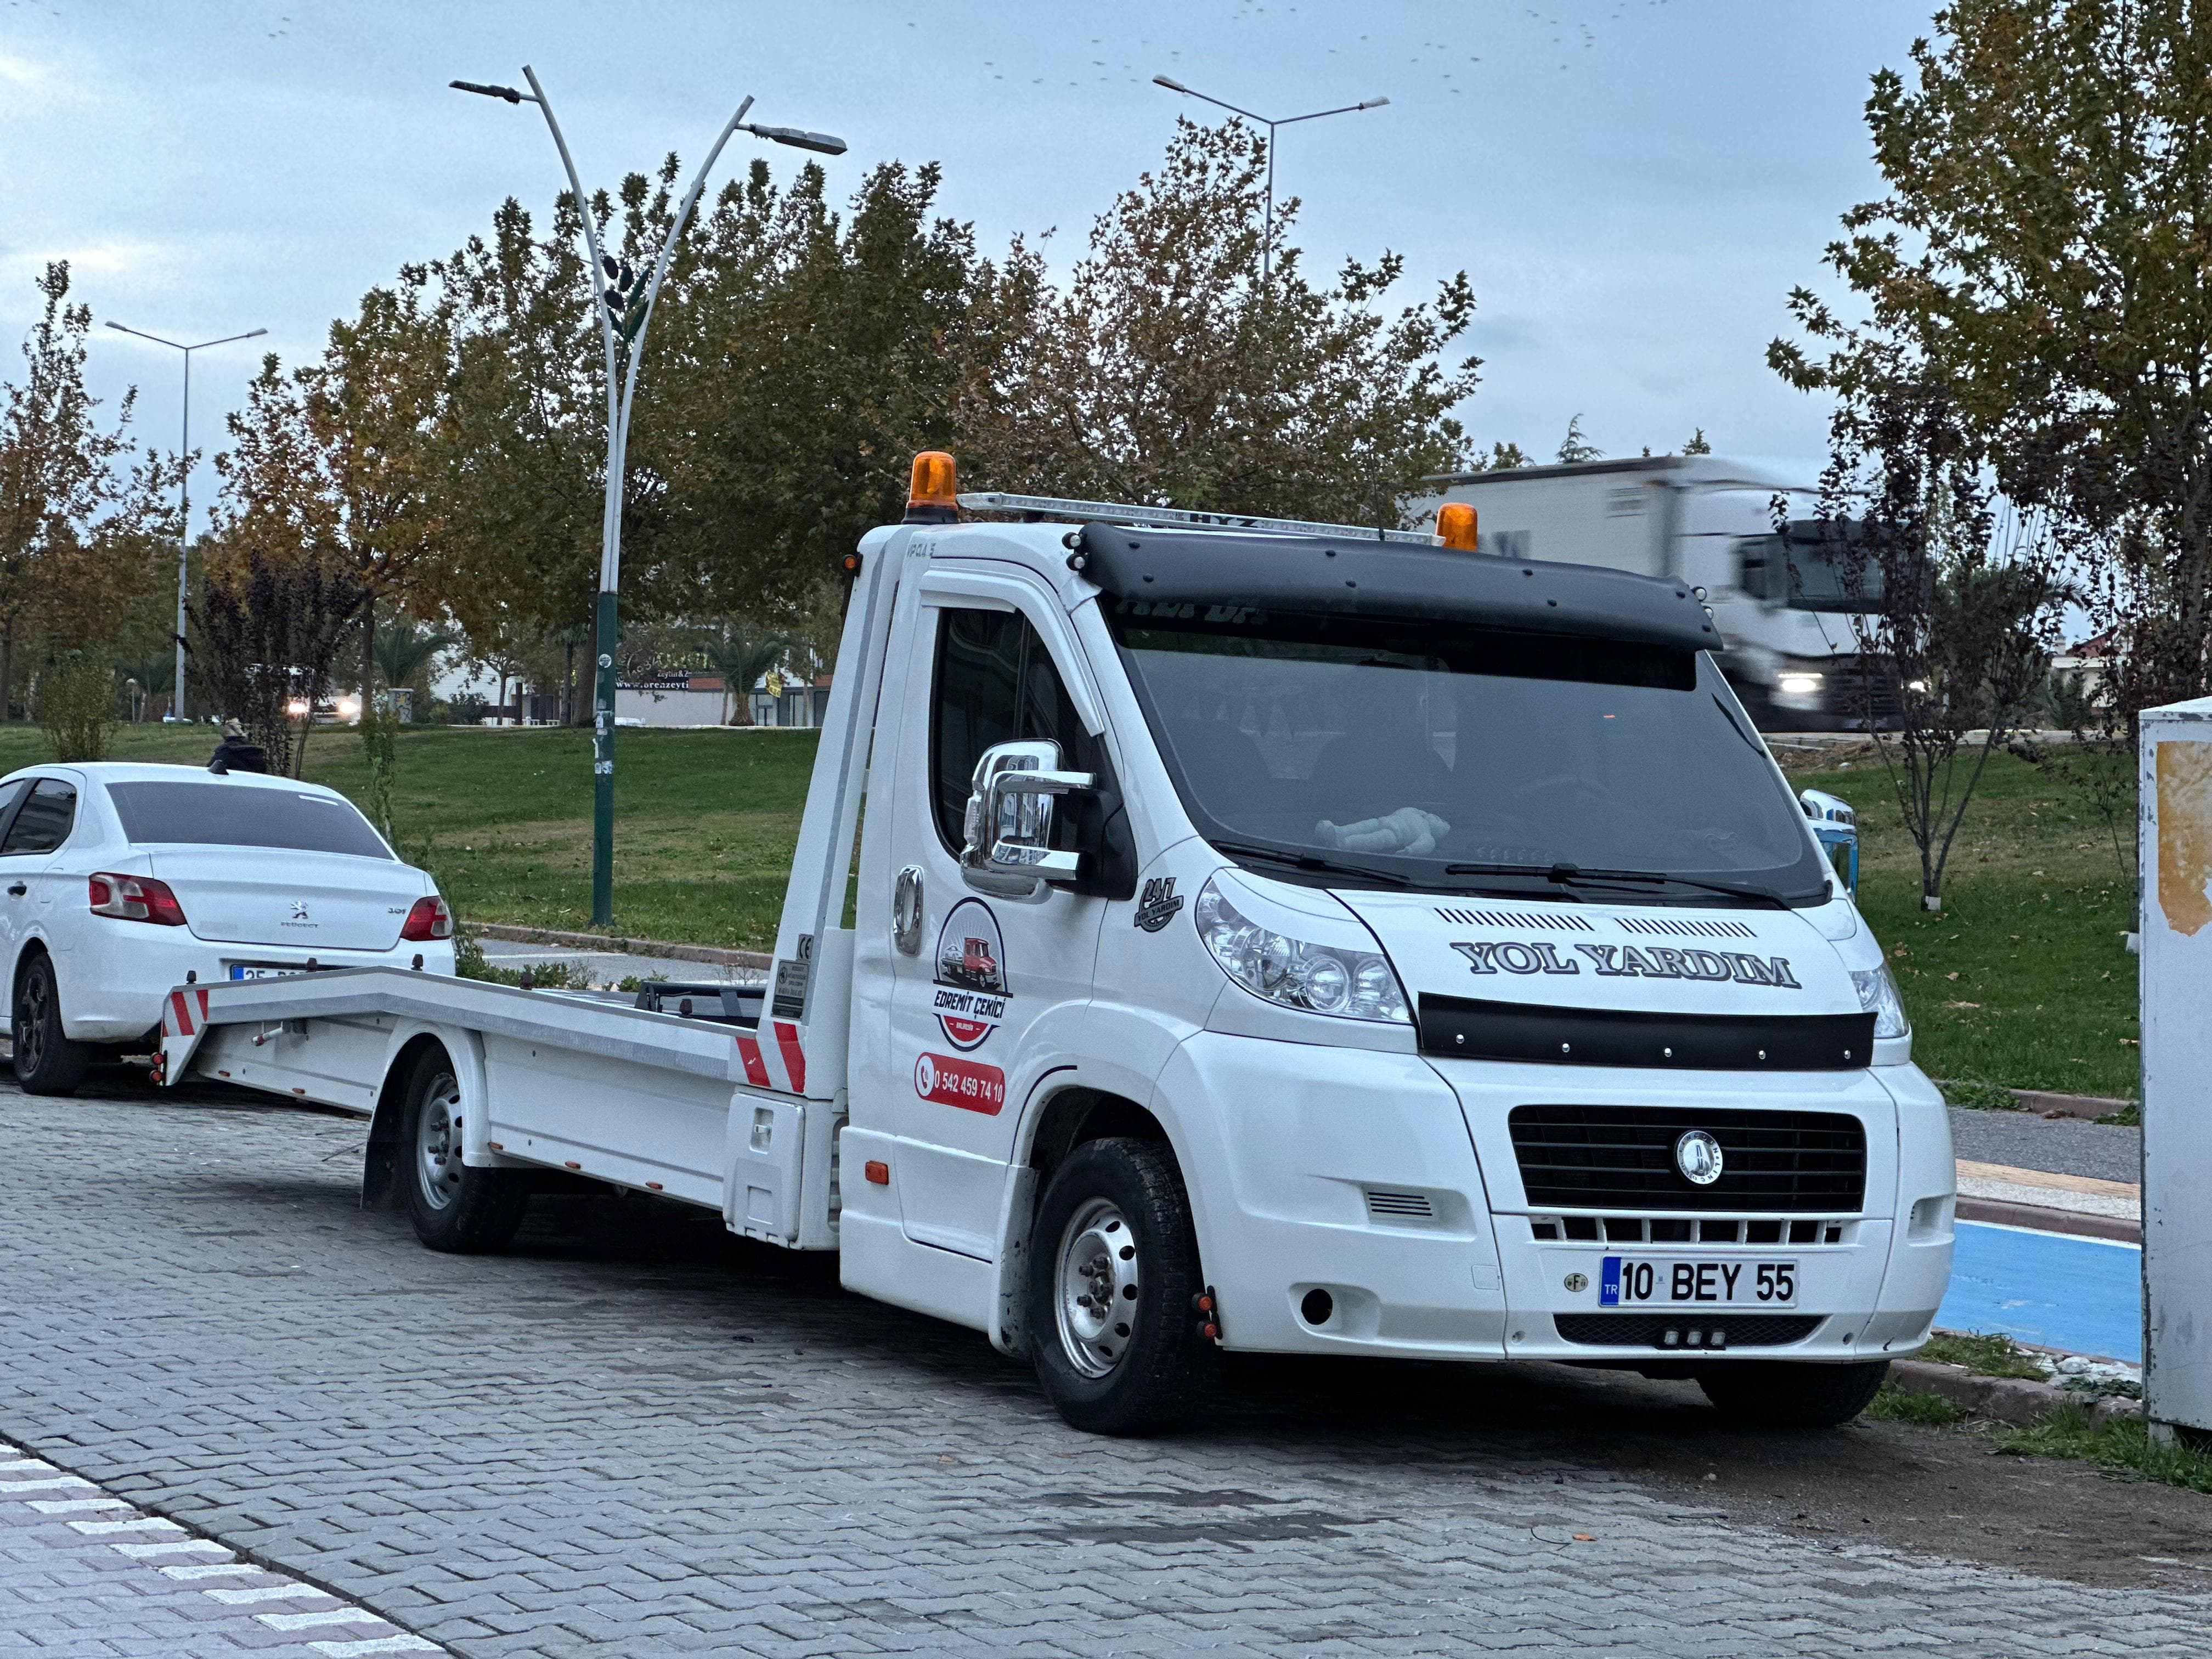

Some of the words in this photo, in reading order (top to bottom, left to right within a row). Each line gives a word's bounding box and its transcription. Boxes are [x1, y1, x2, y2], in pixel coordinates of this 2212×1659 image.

[1144, 877, 1176, 902] 24/7
[1138, 912, 1149, 922] YOL
[1152, 899, 1180, 916] YARDIM
[1450, 941, 1579, 975] YOL
[1575, 944, 1802, 989] YARDIM
[934, 990, 974, 1012] EDREMİT
[973, 996, 1006, 1019] ÇEKİCİ
[934, 1070, 940, 1088] 0
[942, 1072, 958, 1092] 542
[961, 1076, 978, 1097] 459
[980, 1080, 991, 1100] 74
[994, 1083, 1003, 1103] 10
[1605, 1284, 1618, 1295] TR
[1623, 1262, 1653, 1300] 10
[1672, 1263, 1742, 1301] BEY
[1757, 1264, 1795, 1301] 55
